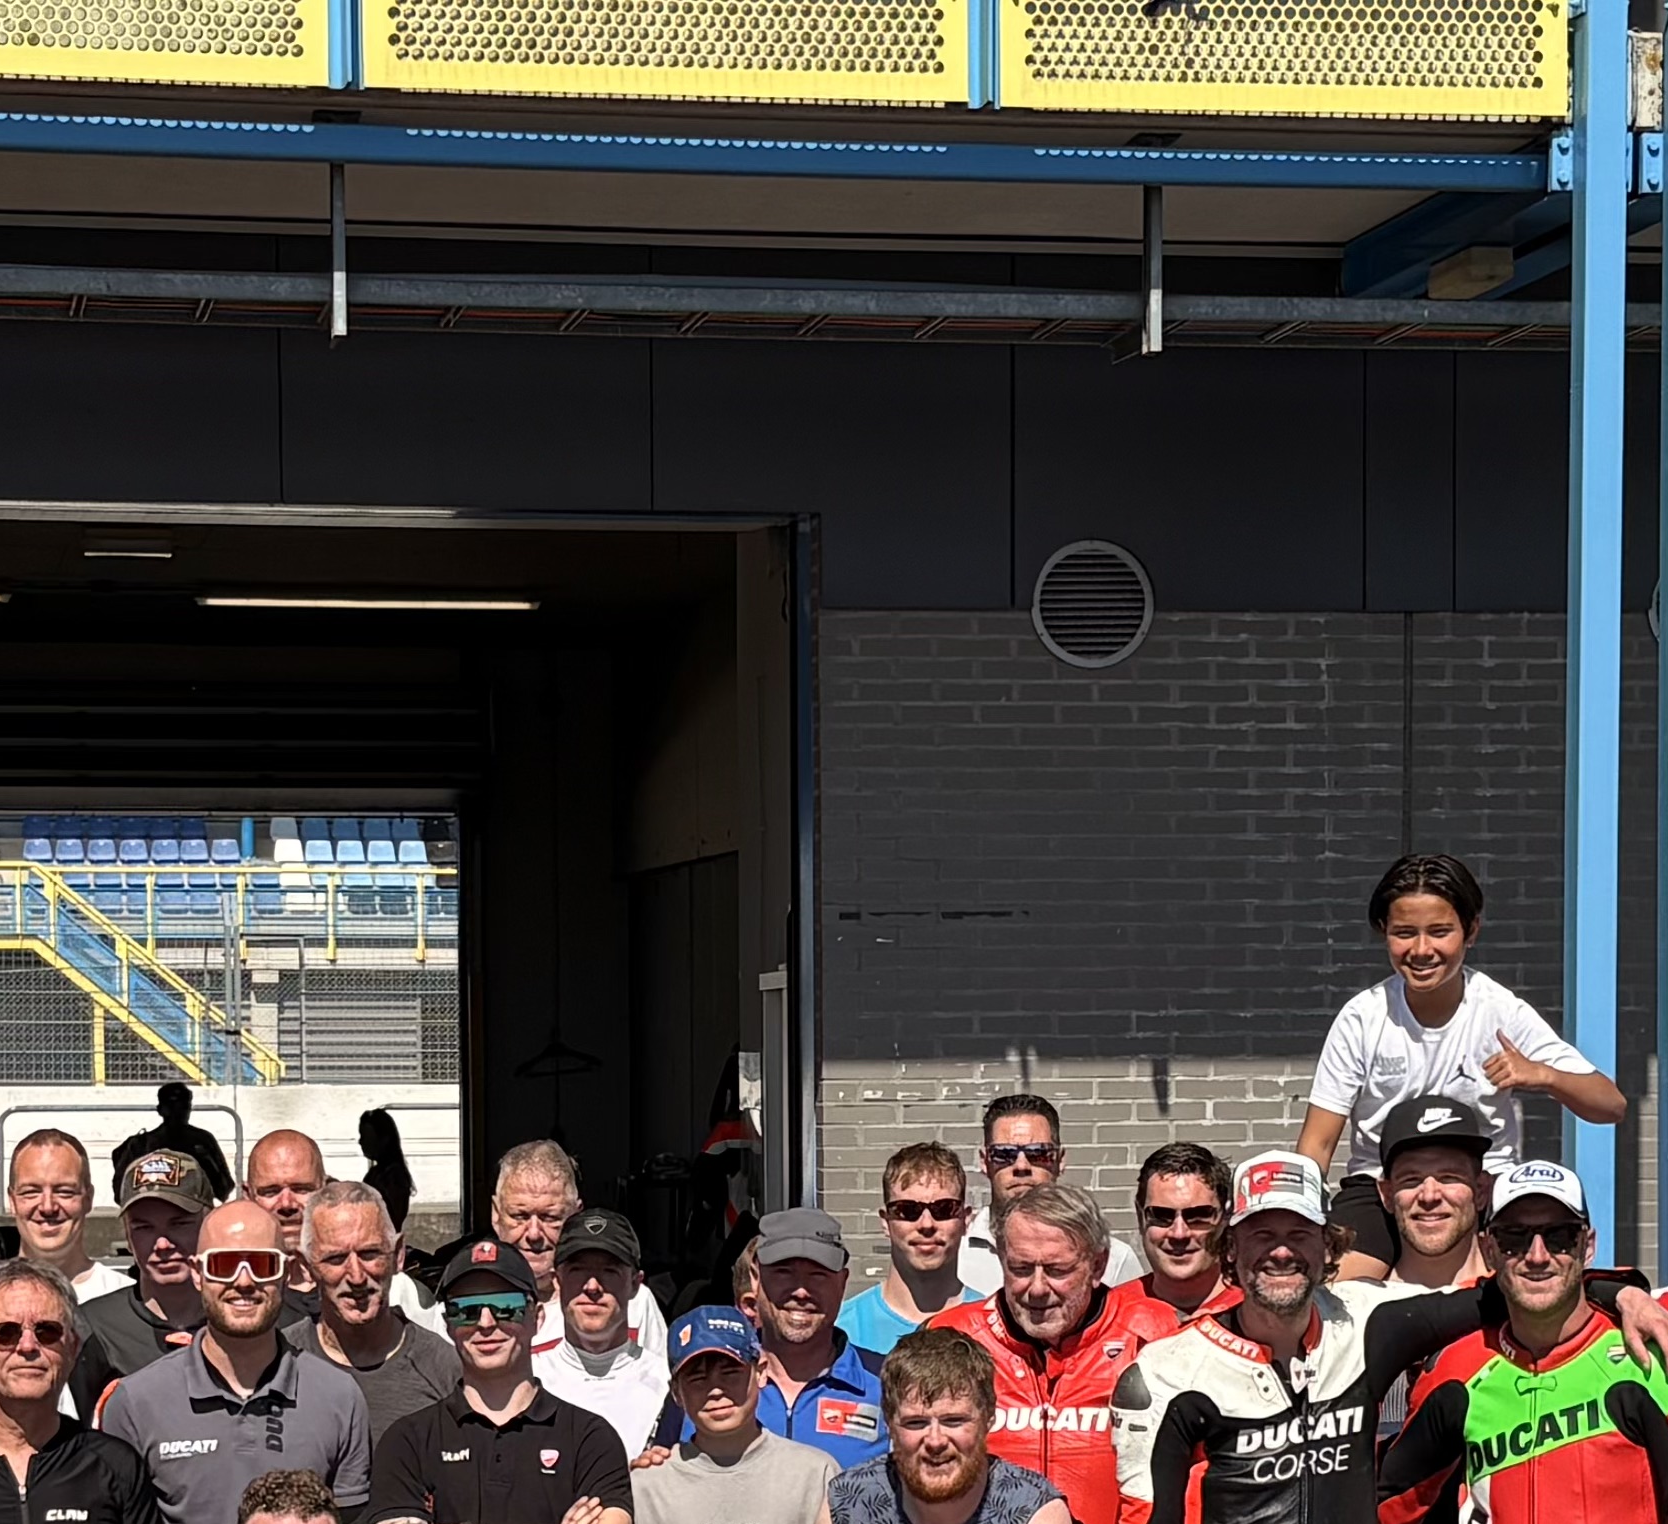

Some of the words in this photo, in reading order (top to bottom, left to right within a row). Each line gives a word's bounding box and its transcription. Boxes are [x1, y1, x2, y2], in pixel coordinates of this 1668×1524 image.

[1199, 1320, 1259, 1359] DUCATI
[160, 1439, 218, 1455] DUCATI
[1236, 1406, 1365, 1455] DUCATI
[1470, 1399, 1600, 1478] DUCATI
[1254, 1443, 1351, 1483] CORSE
